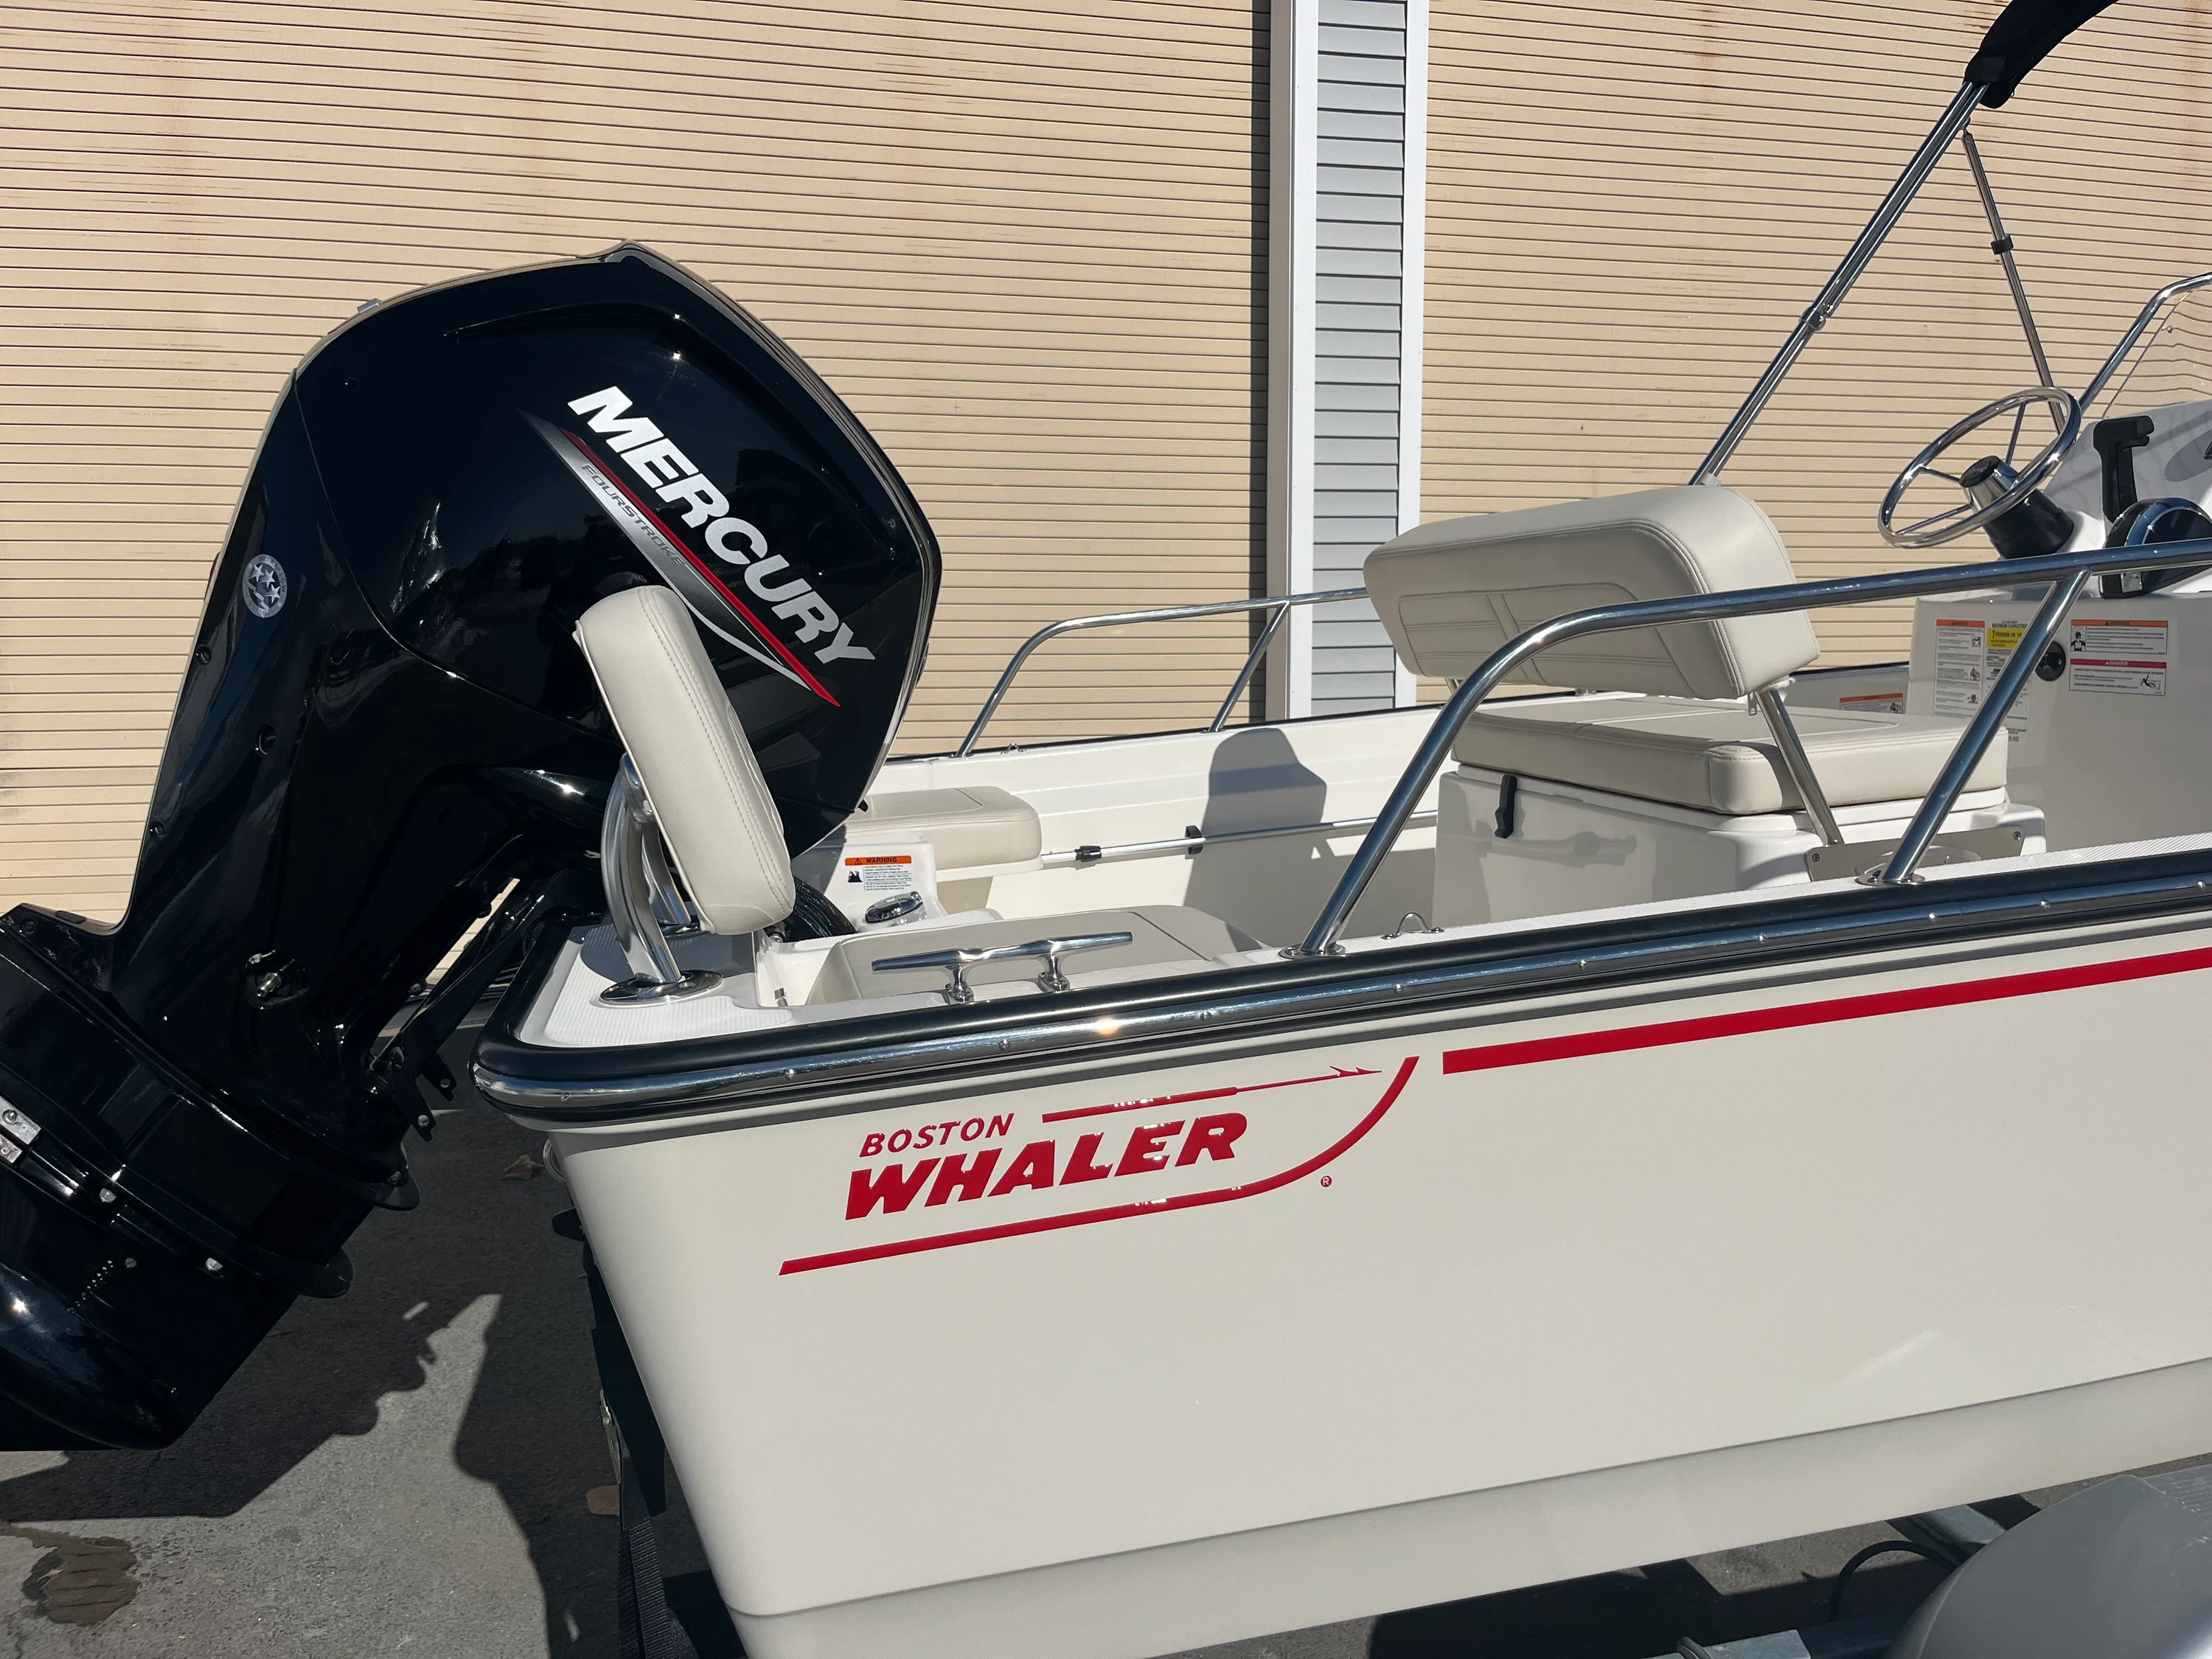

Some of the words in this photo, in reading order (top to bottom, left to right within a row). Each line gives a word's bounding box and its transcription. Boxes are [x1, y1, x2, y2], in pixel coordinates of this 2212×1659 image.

[567, 386, 876, 664] MERCURY
[580, 463, 686, 566] FOURSTROKE
[845, 1112, 1248, 1220] WHALER
[859, 1113, 1015, 1158] BOSTON
